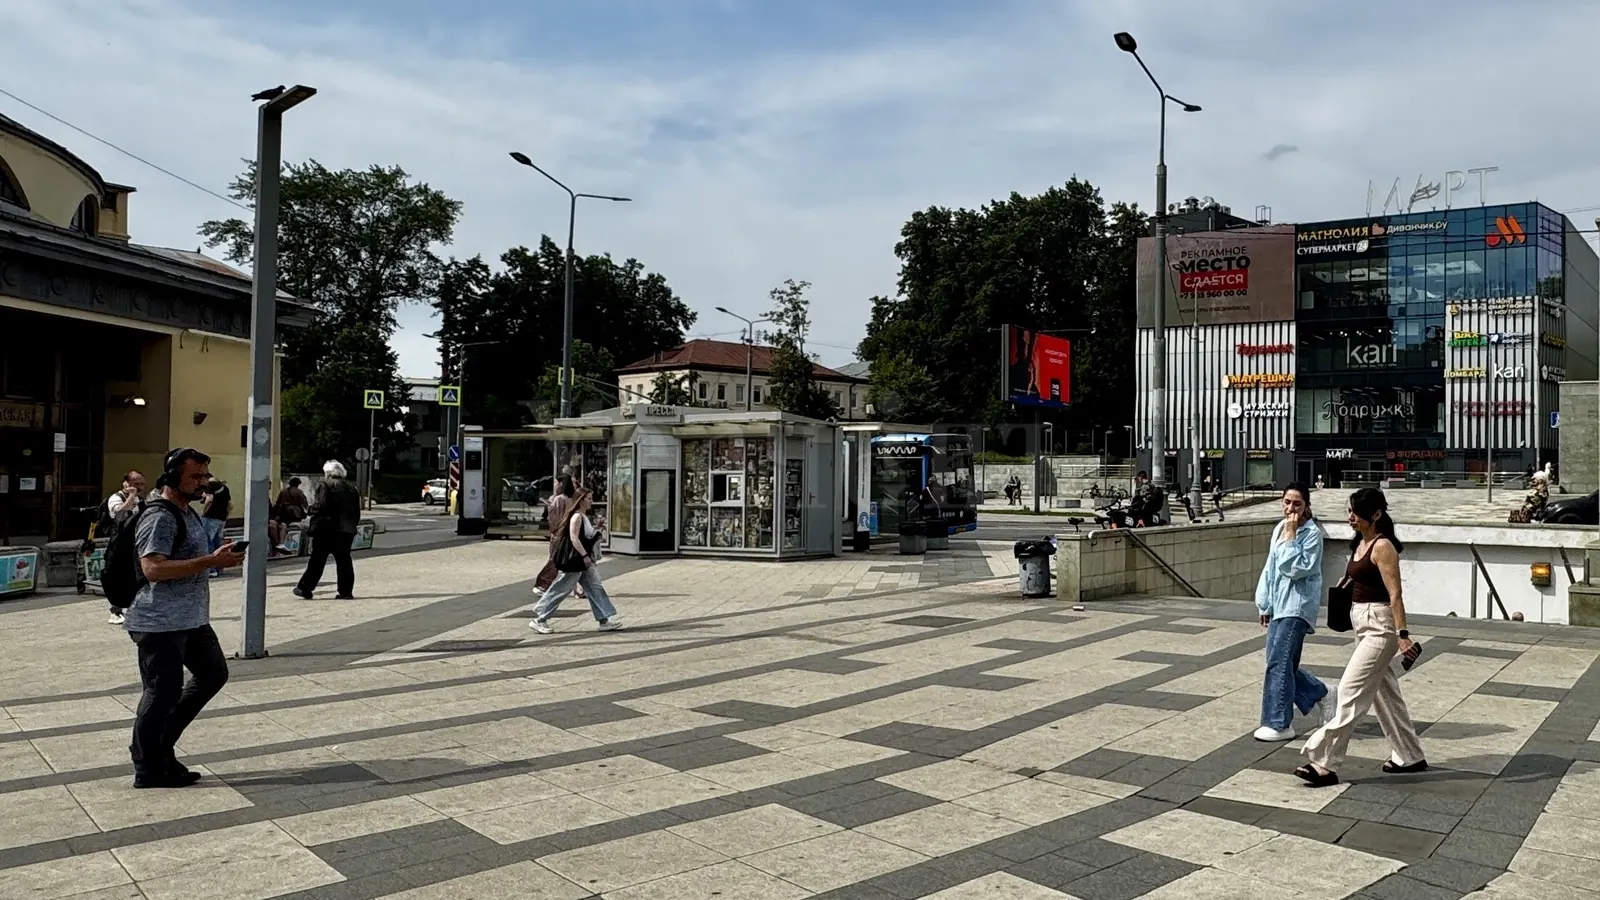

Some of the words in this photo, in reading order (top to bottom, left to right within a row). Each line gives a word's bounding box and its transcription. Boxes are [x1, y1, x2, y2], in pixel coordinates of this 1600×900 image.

[1297, 226, 1369, 242] МАГНОЛИЯ
[1181, 246, 1247, 259] РЕКЛАМНОЕ
[1297, 243, 1357, 256] СУПЕРМАРКЕТ
[1447, 339, 1487, 347] АПТЕКА
[1347, 338, 1397, 364] kari
[1494, 363, 1524, 378] kari
[1230, 374, 1294, 383] МАТРЕШКА
[645, 406, 676, 416] ПРЕССА
[1244, 402, 1289, 410] МУЖСКИЕ
[1322, 400, 1414, 420] Подружка
[1326, 448, 1353, 459] МАРТ
